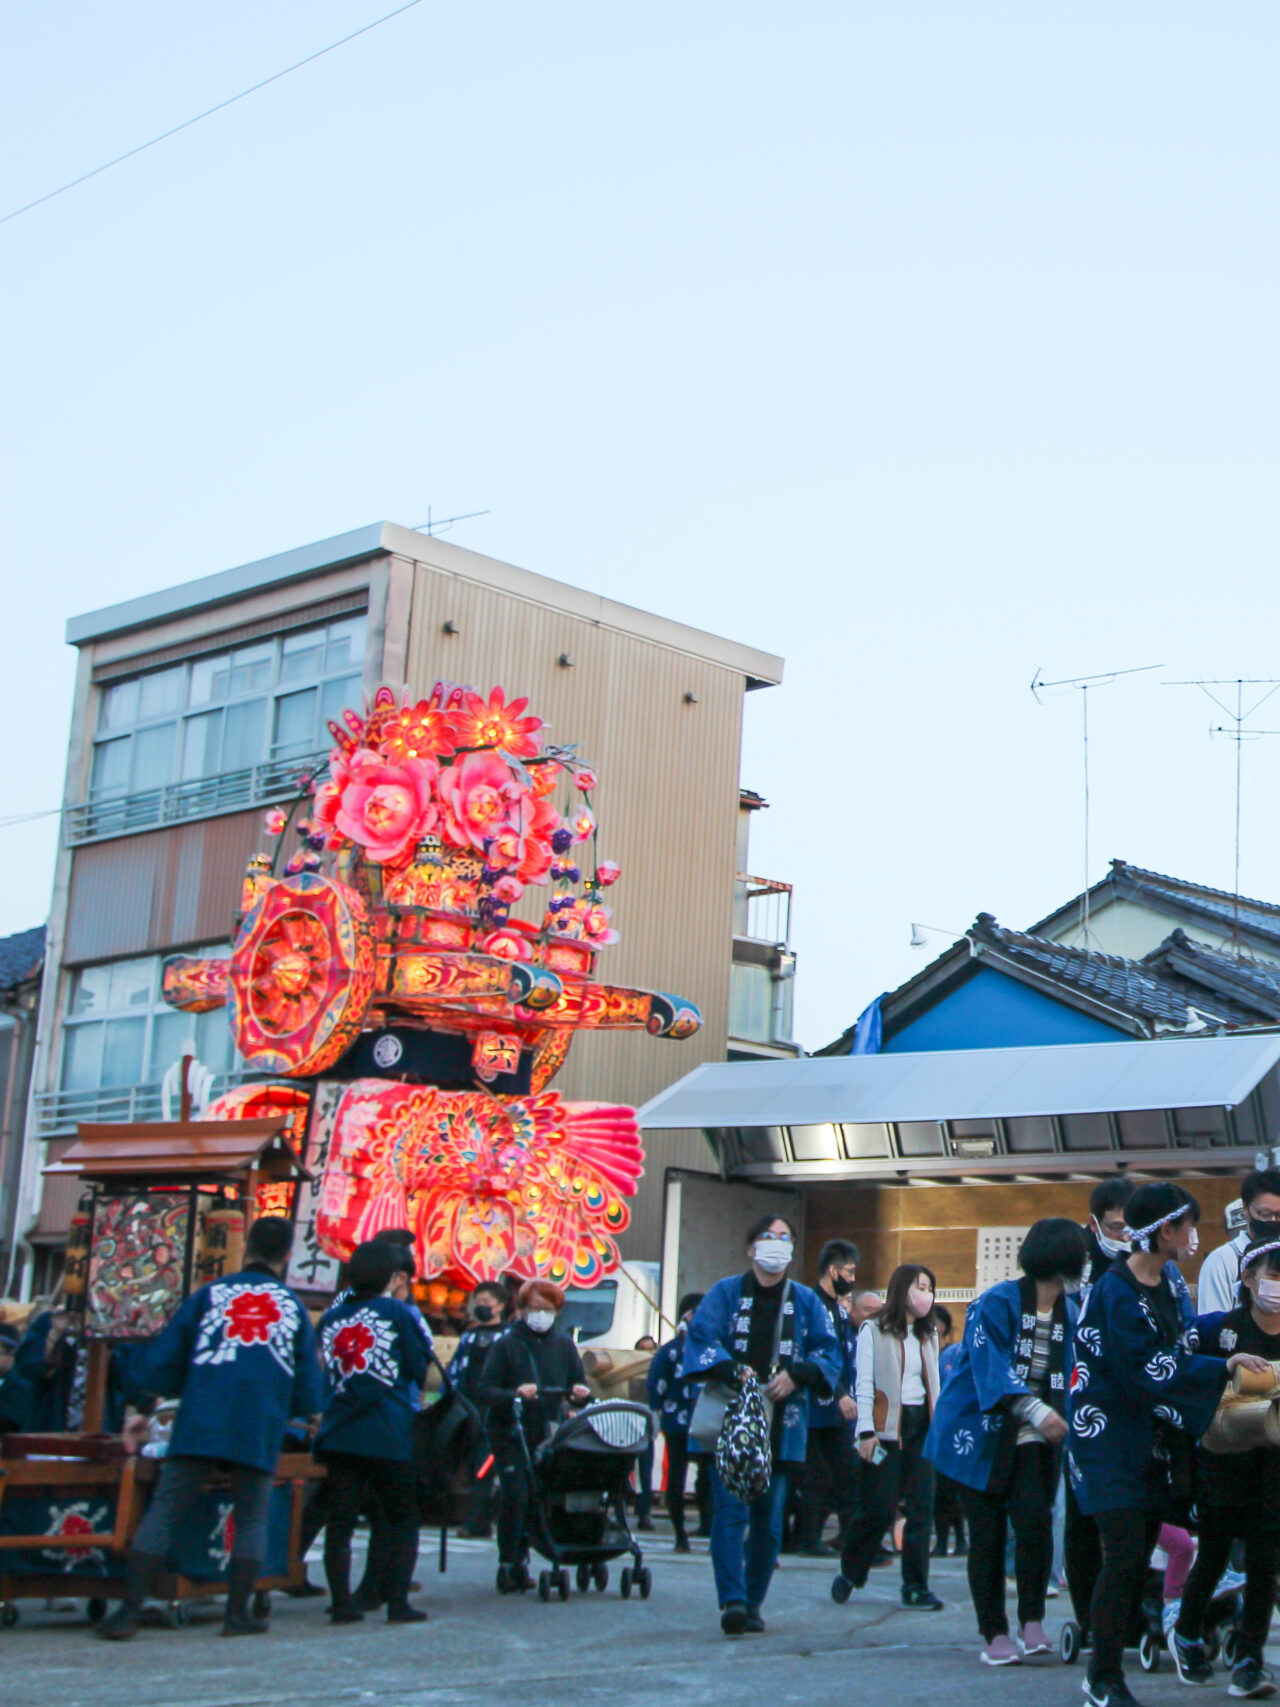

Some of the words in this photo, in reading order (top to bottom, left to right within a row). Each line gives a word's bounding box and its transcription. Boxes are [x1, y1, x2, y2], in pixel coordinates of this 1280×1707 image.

[488, 1039, 516, 1069] 六
[1015, 1314, 1036, 1380] 御蔵町
